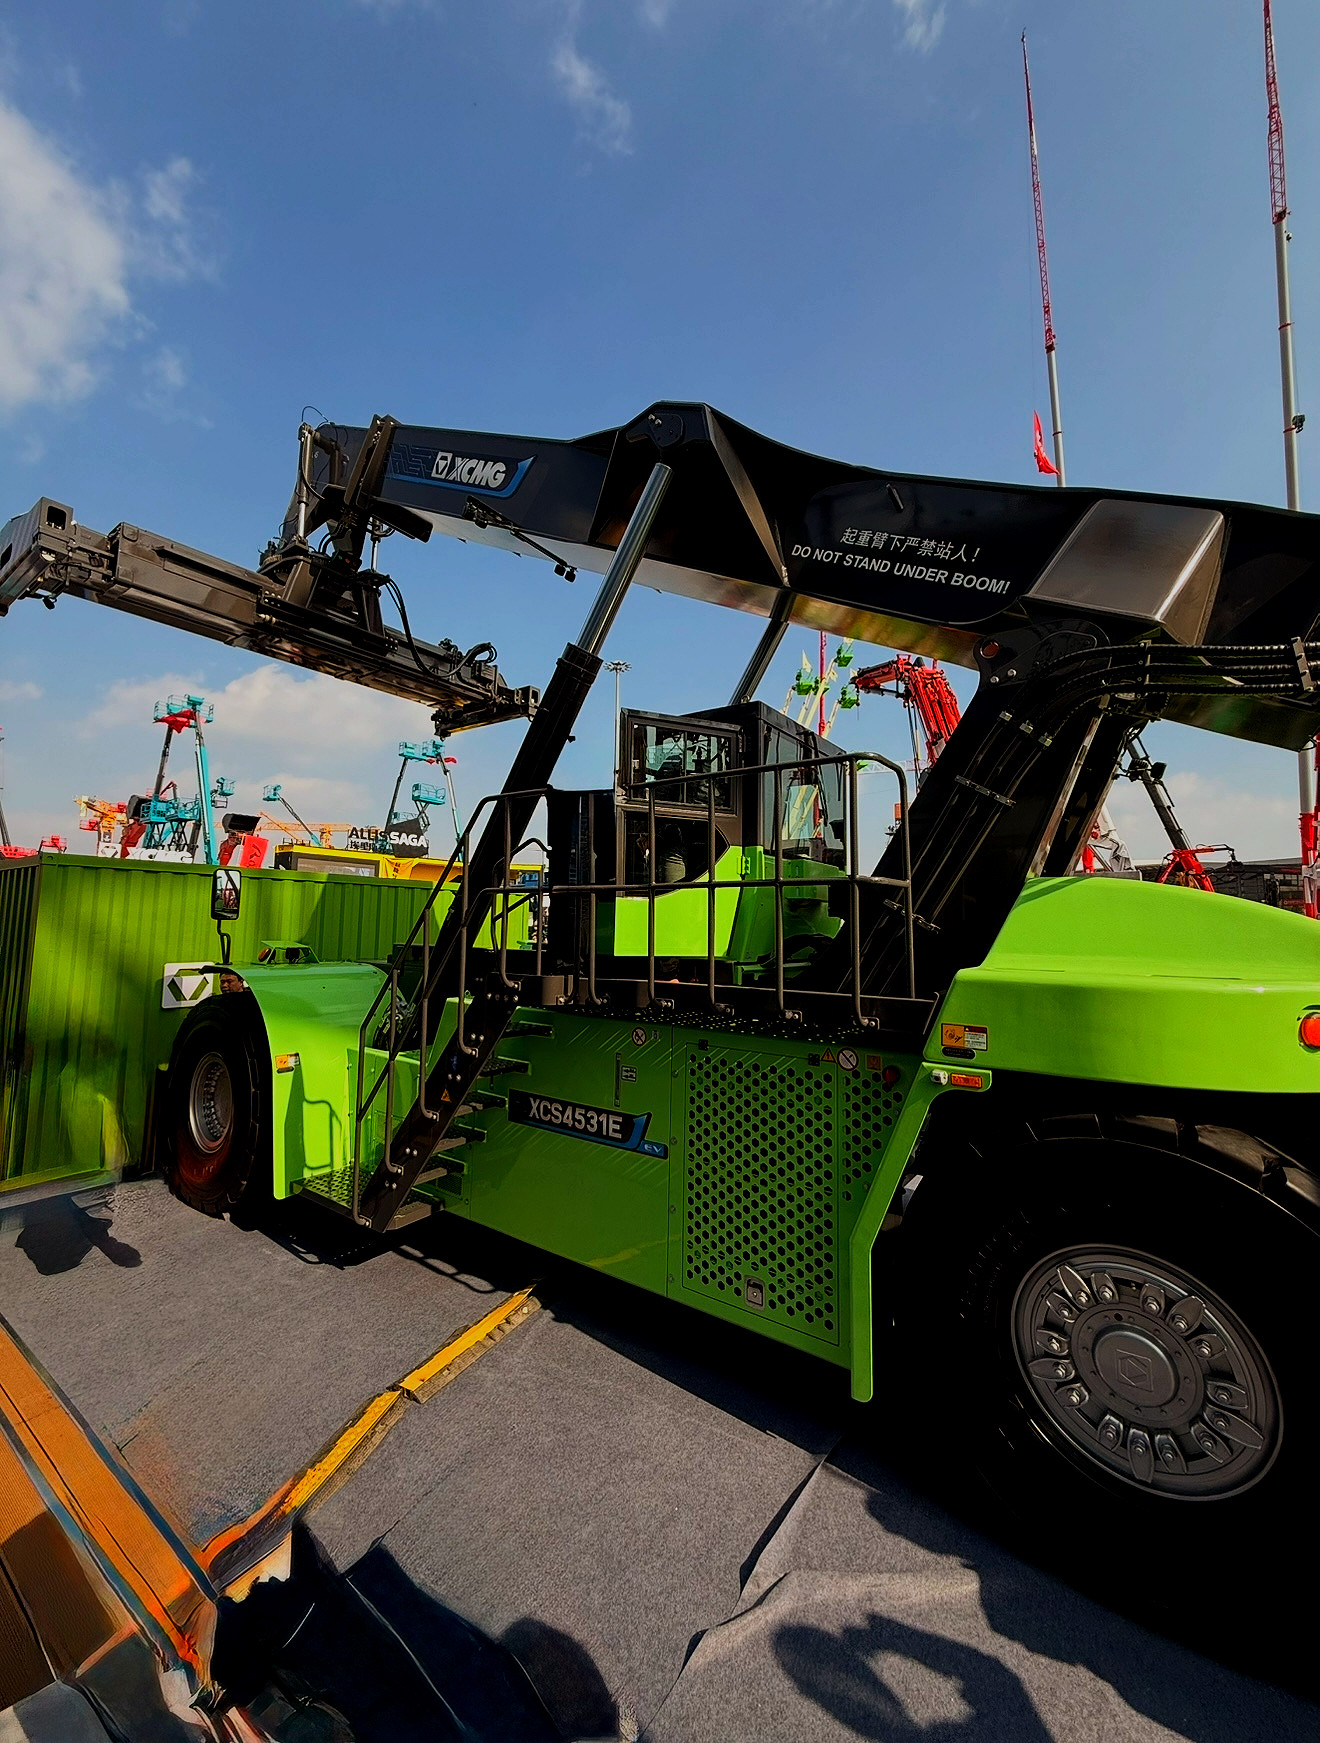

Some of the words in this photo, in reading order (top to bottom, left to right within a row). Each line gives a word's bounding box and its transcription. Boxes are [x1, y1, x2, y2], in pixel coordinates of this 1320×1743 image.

[446, 457, 507, 488] XCMG
[792, 544, 812, 558] DO
[812, 548, 843, 564] NOT
[843, 554, 891, 573] STAND
[893, 562, 949, 584] UNDER
[950, 572, 1011, 595] BOOM!
[389, 831, 428, 847] SAGA
[528, 1096, 623, 1139] XCS4531E
